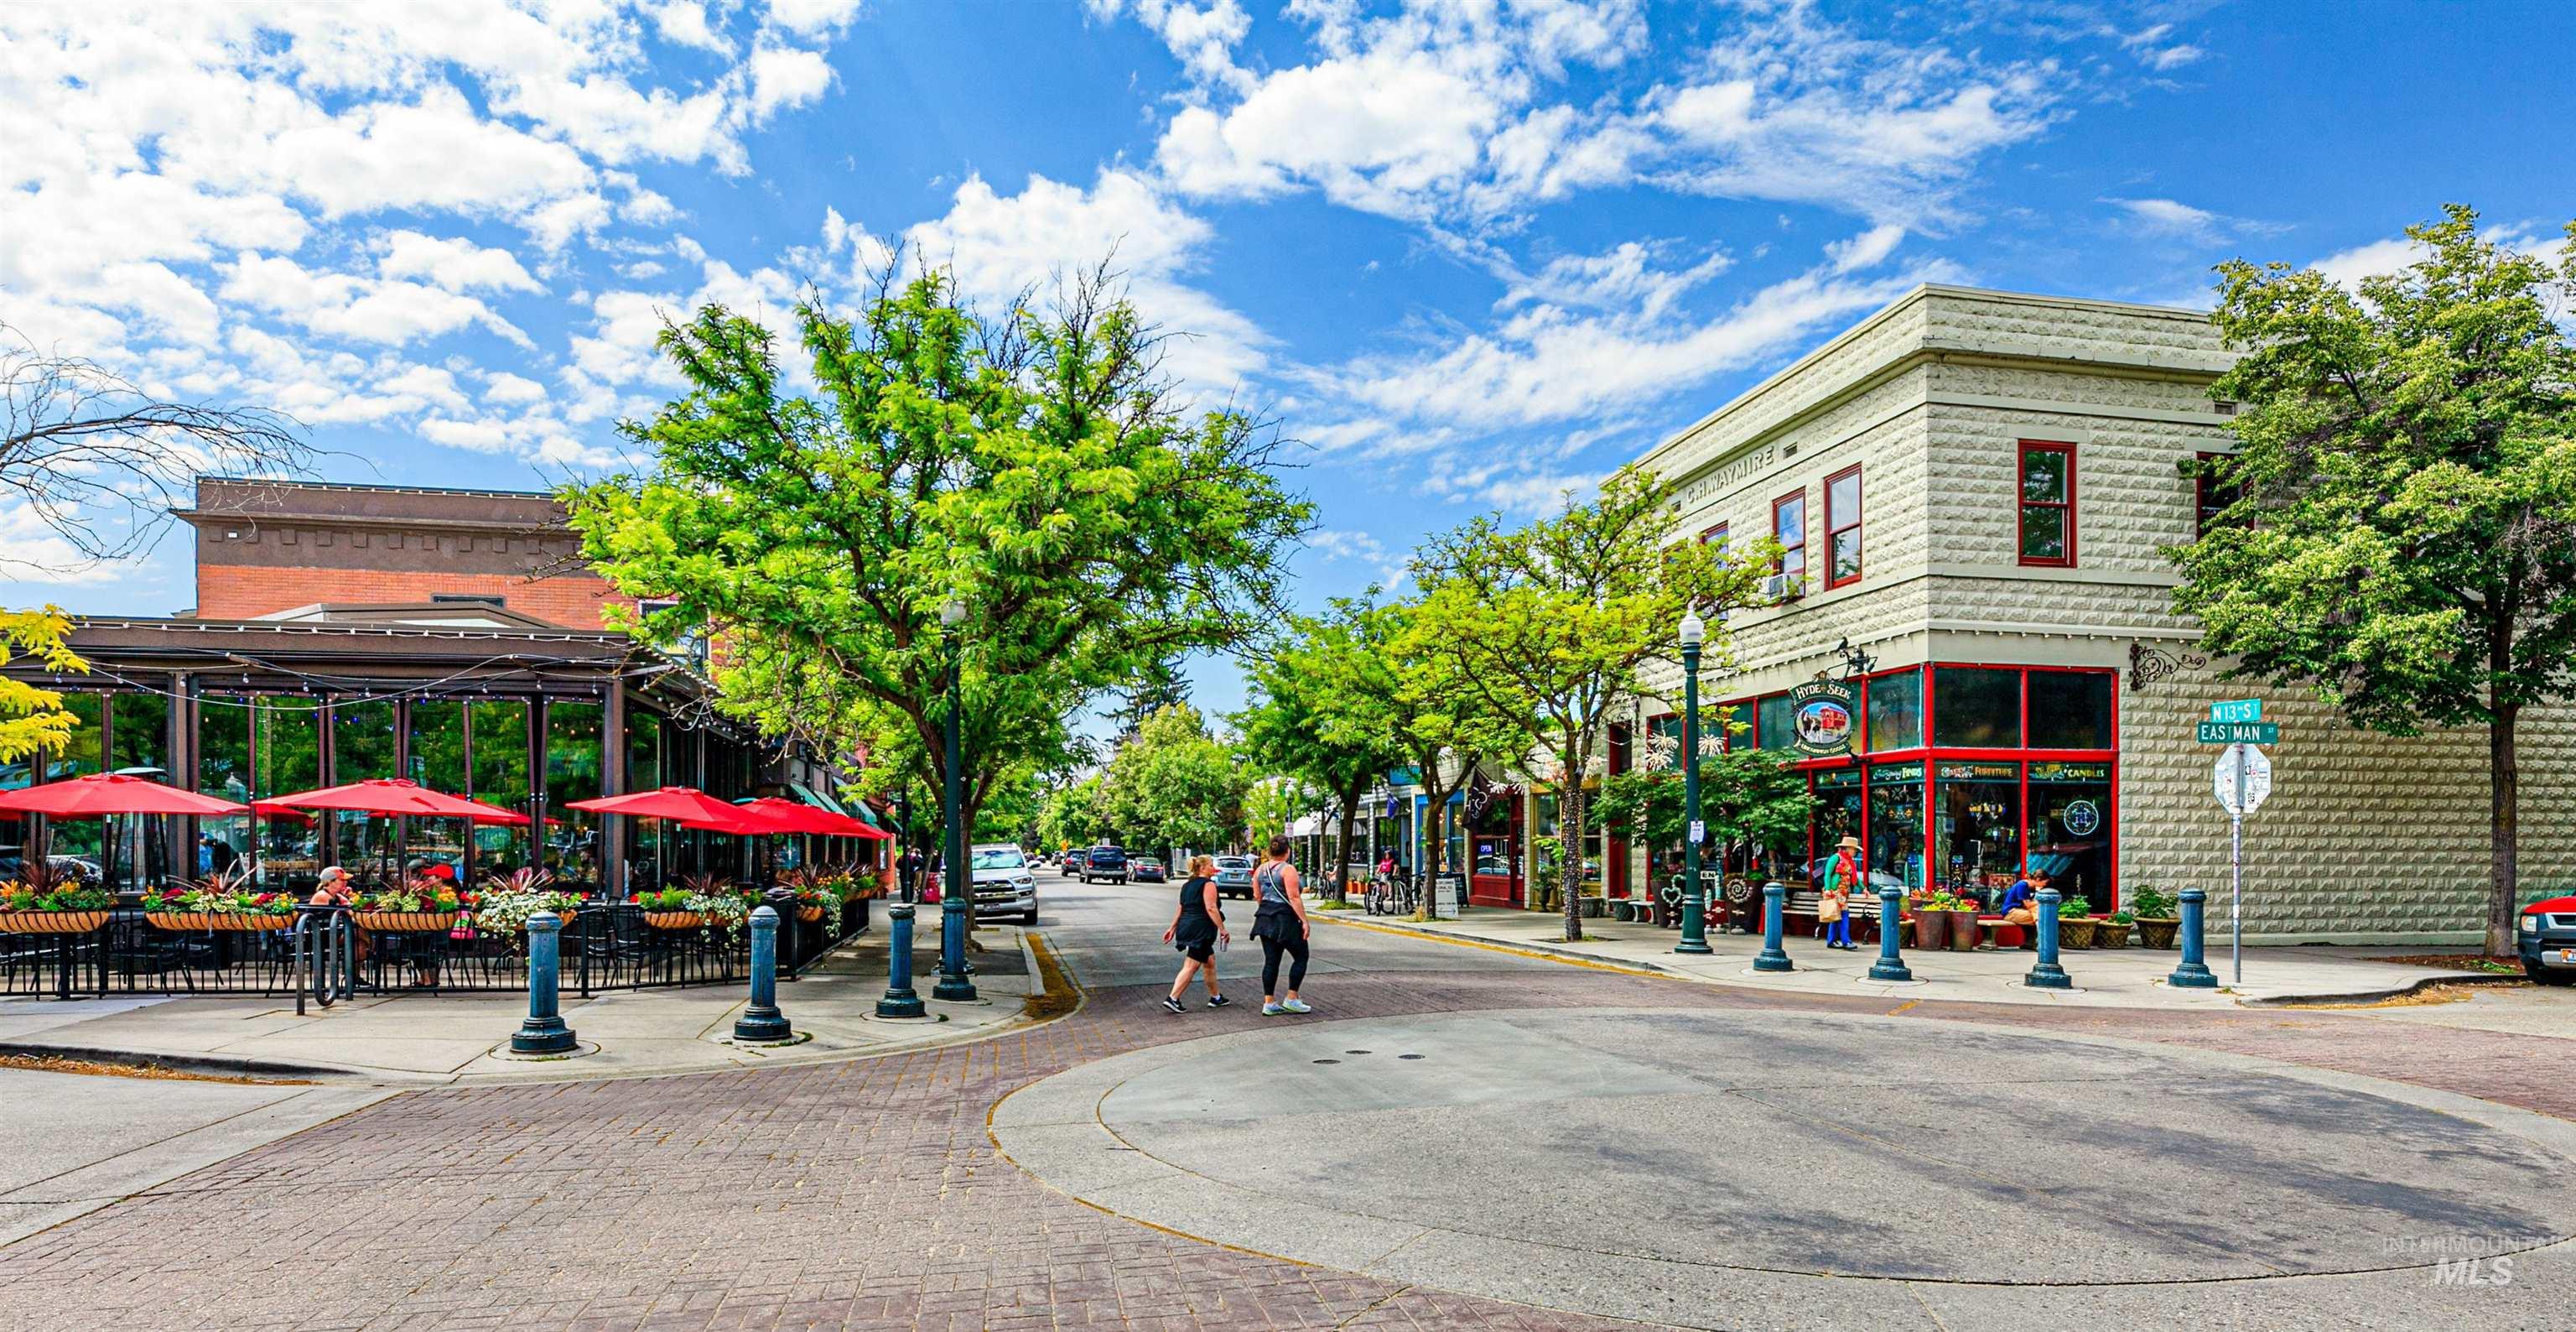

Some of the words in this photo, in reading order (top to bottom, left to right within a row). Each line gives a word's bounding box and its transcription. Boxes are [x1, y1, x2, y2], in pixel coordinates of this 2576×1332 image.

[1796, 684, 1820, 699] HYDE
[1826, 684, 1852, 700] SEEK
[2213, 707, 2221, 721] N
[2243, 703, 2258, 719] ST
[2201, 725, 2260, 741] EASTMAN
[2067, 768, 2105, 778] CANDLES
